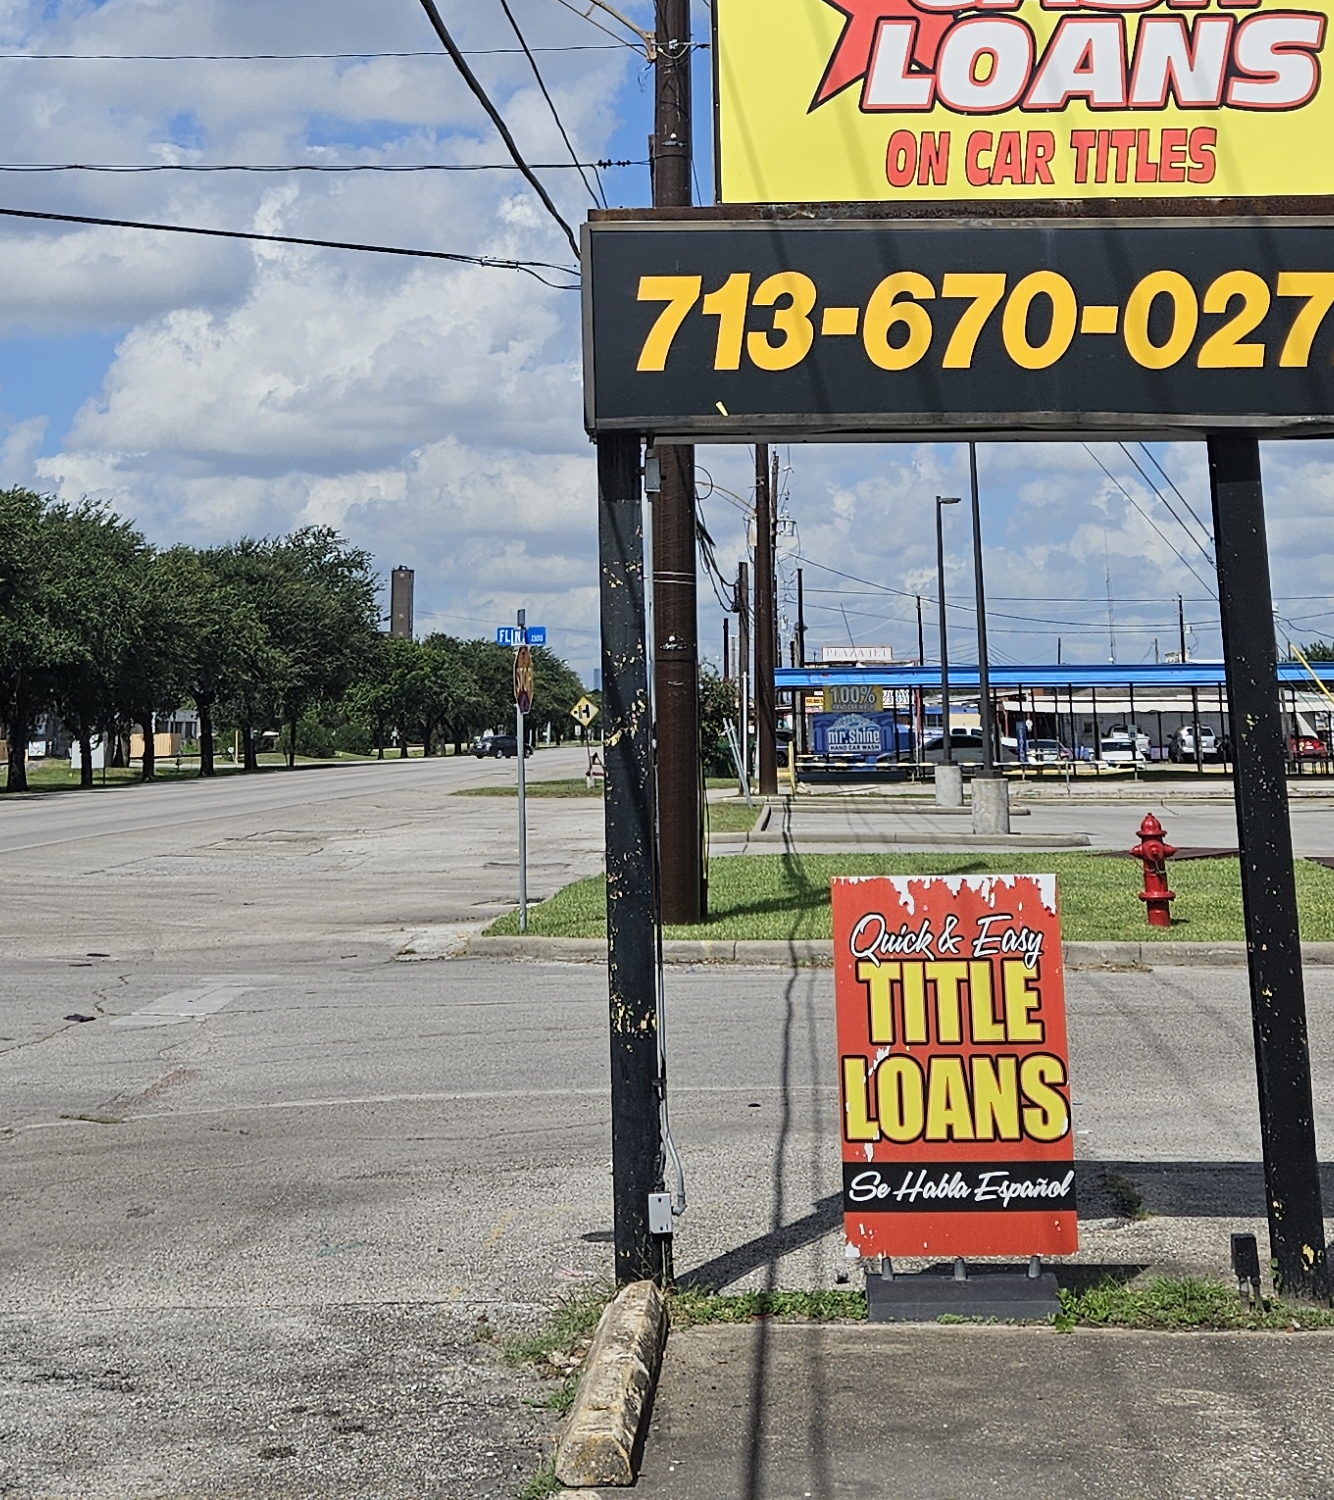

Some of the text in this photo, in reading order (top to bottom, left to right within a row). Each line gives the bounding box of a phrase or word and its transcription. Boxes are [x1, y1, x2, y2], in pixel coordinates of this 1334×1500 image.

[860, 10, 1328, 113] LOANS
[886, 127, 1217, 187] ON CAR TITLES
[826, 649, 864, 657] PLAZA
[830, 686, 876, 703] 100%
[850, 912, 1044, 969] Quick & Easy
[856, 958, 1044, 1045] TITLE
[842, 1053, 1071, 1144] LOANS
[849, 1169, 1075, 1208] Se Habla Español
